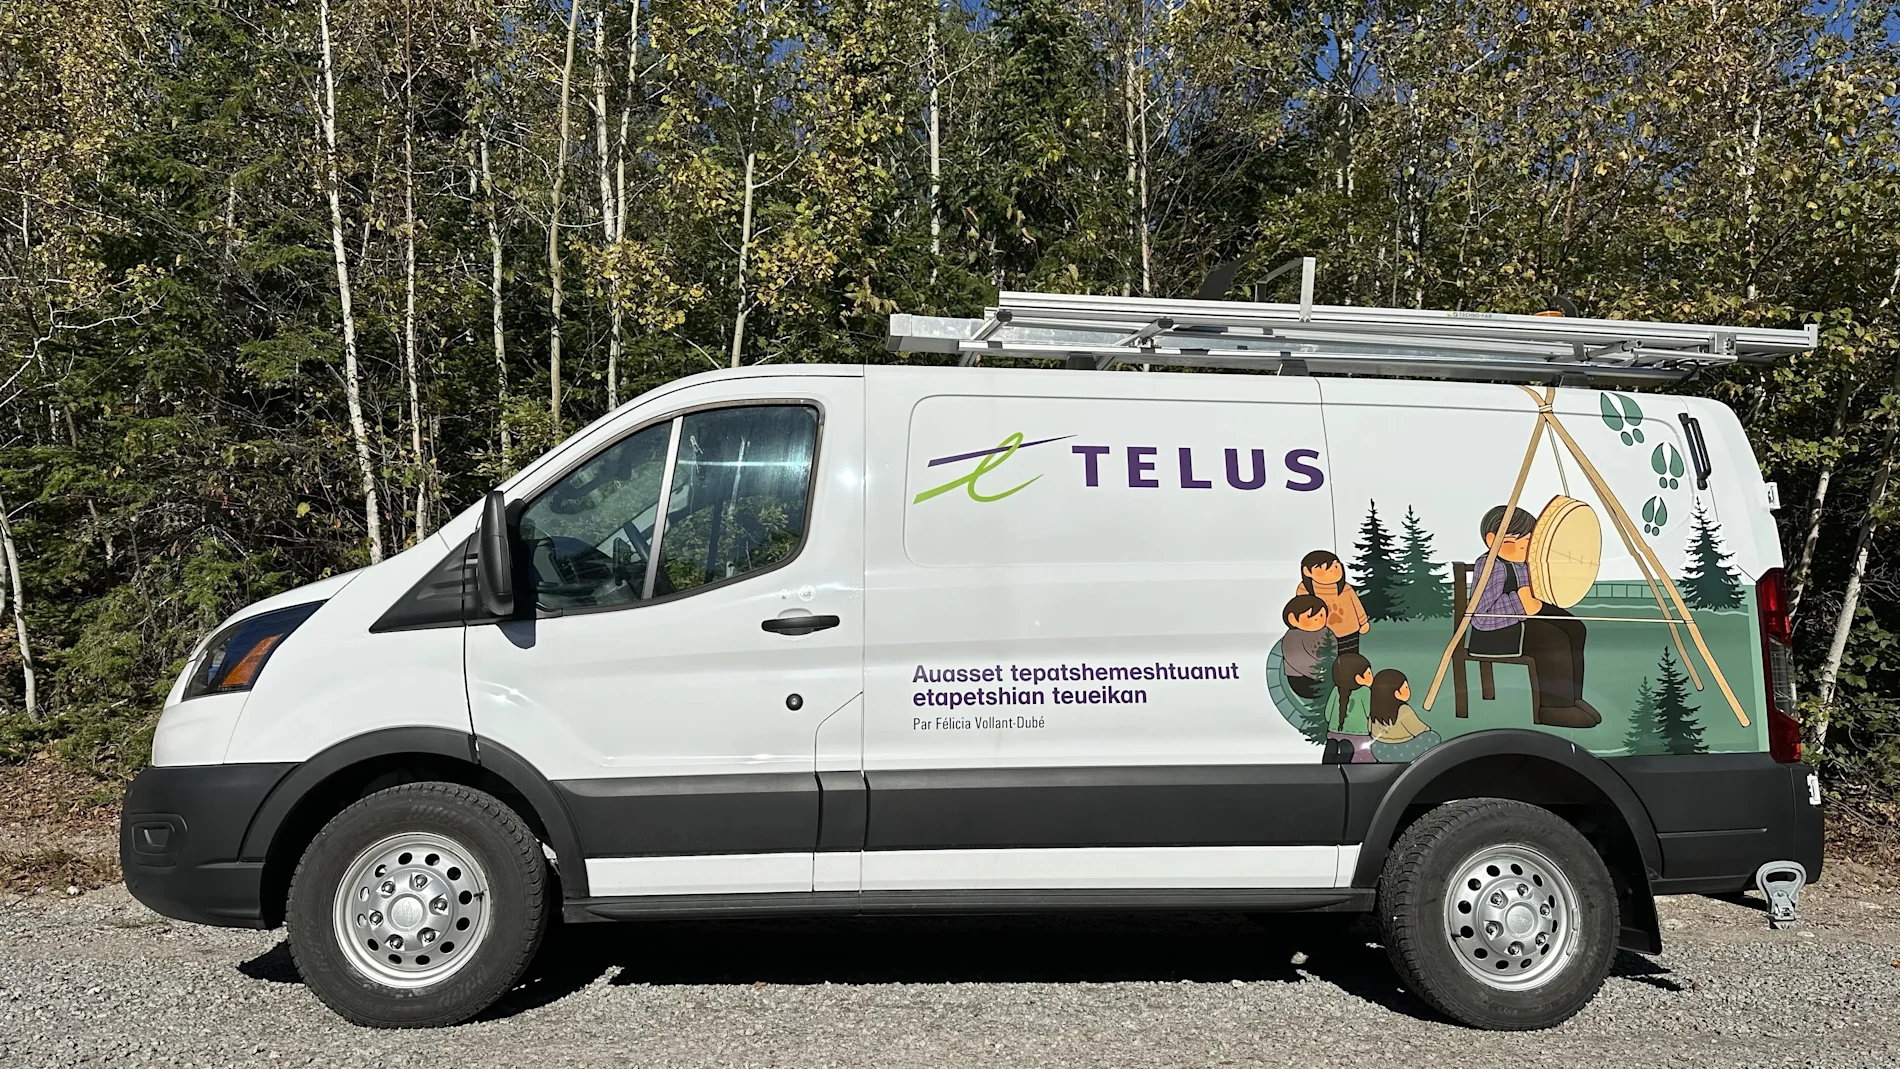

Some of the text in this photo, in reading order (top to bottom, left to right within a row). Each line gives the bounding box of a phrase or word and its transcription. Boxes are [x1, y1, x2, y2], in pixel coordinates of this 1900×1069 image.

[1071, 445, 1325, 492] TELUS
[912, 662, 1240, 685] Auasset tepatshemeshtuanut
[913, 685, 1147, 710] etapetshian teueikan
[913, 715, 1045, 730] Par Félicia Vollant-Dubé
